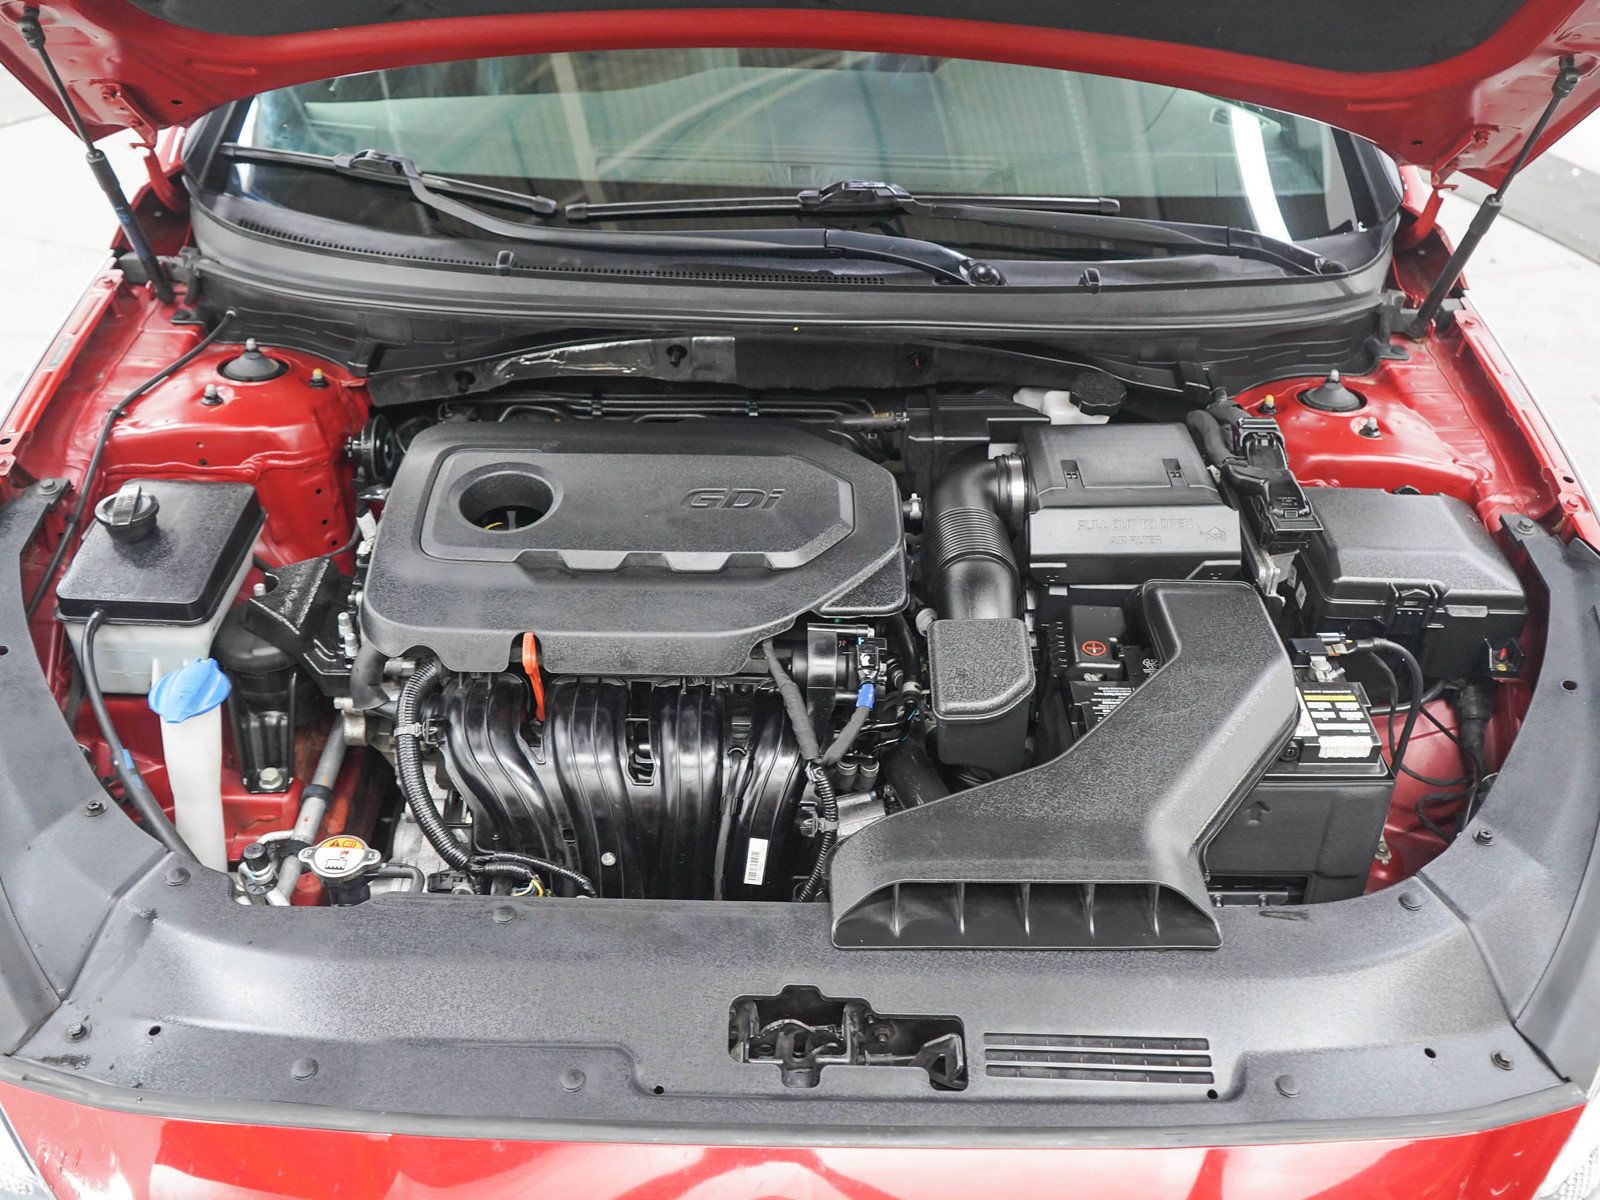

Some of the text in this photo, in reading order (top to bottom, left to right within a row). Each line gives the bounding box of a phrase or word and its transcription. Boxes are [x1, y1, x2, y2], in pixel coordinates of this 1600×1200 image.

[680, 487, 786, 511] GDi
[1077, 517, 1194, 531] PULL OUT TO OPEN
[1129, 534, 1162, 545] FILTER
